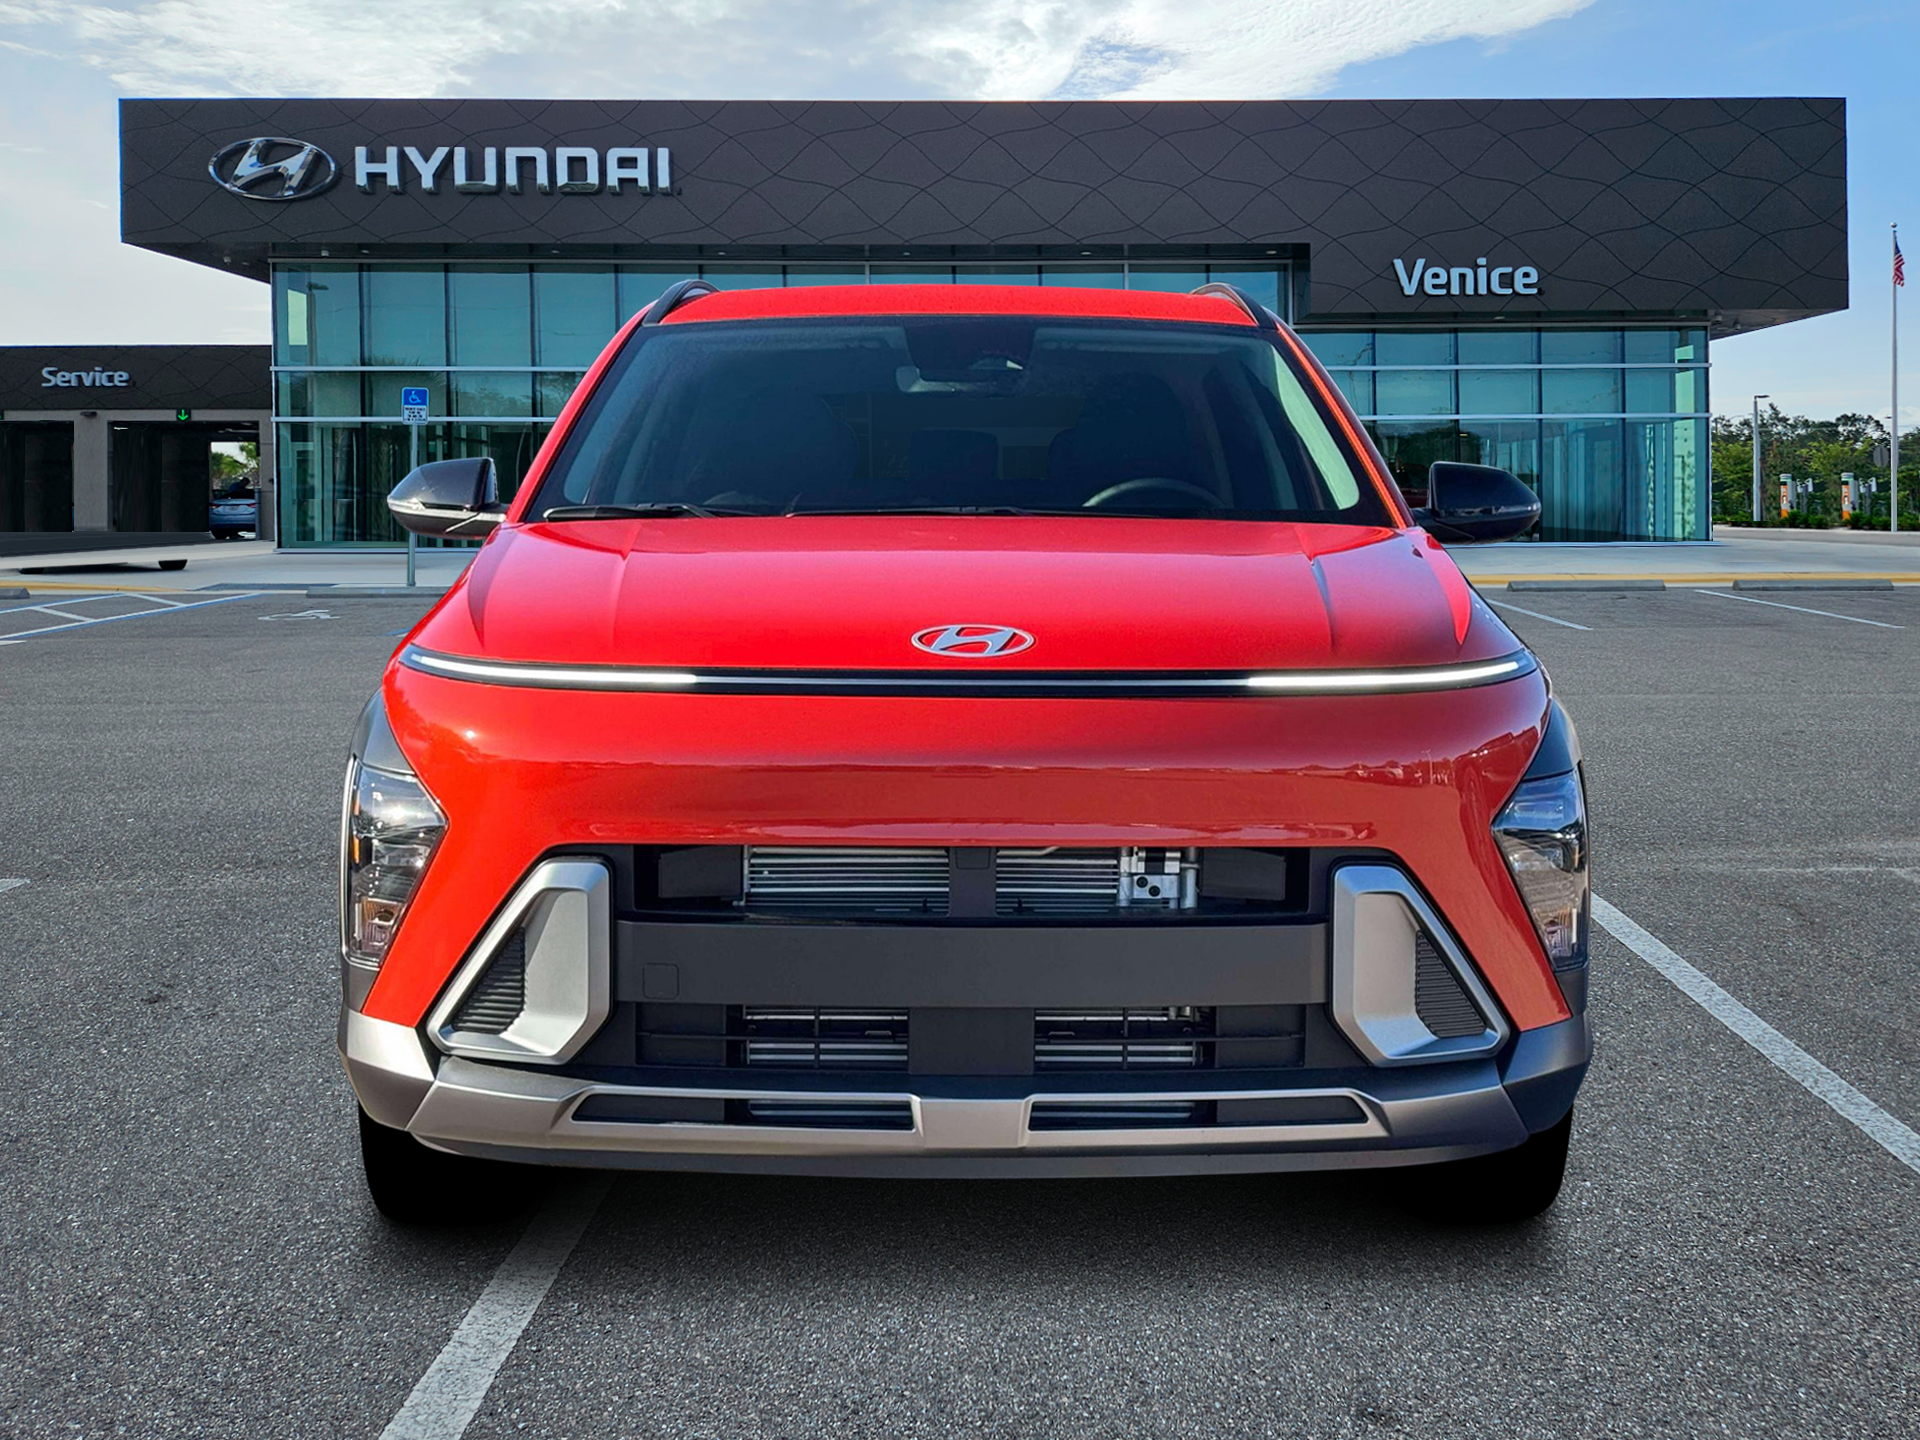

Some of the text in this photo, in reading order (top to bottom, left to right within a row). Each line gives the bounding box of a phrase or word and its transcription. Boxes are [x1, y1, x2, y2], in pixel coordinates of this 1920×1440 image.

[355, 146, 671, 193] HYUNDAI
[1393, 257, 1538, 295] Venice
[41, 367, 129, 387] Service
